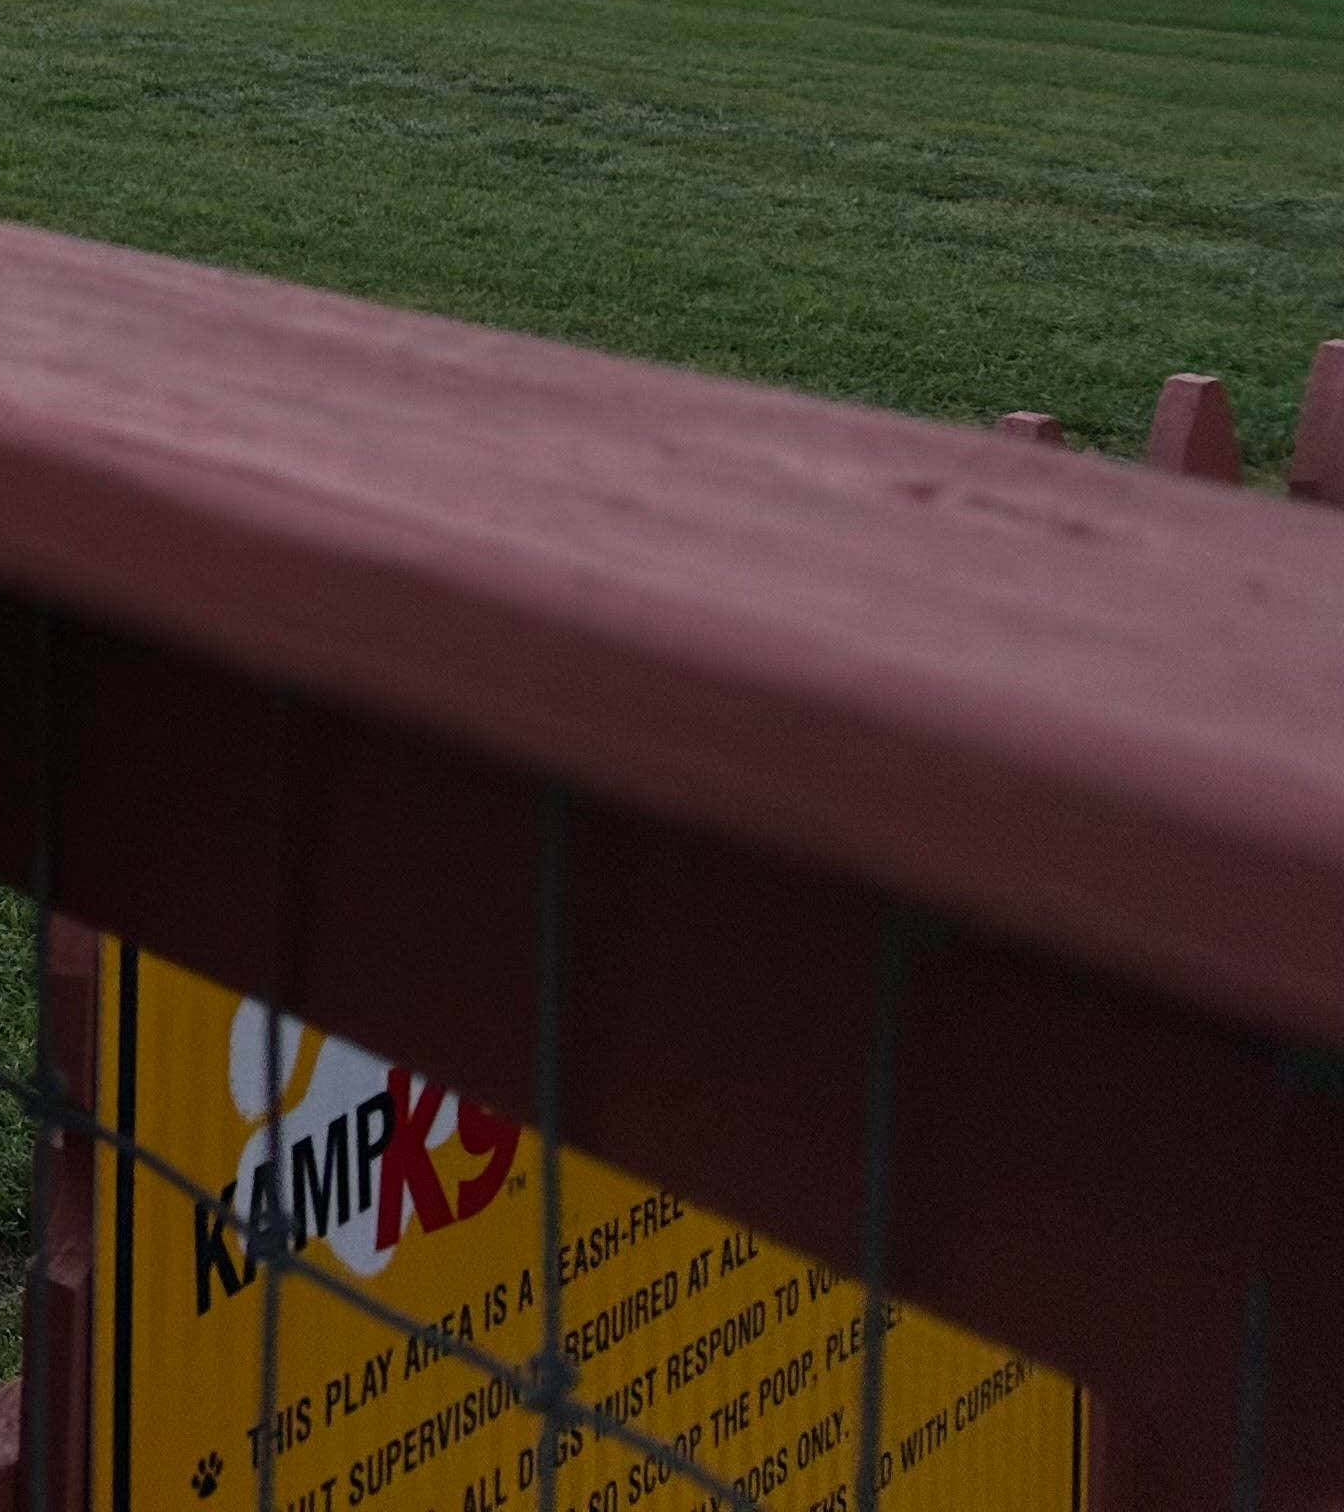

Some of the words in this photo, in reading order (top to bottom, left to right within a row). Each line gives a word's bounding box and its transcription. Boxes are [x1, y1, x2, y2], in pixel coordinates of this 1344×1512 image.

[247, 1396, 312, 1469] THIS
[325, 1349, 394, 1427] PLAY
[485, 1284, 507, 1332] IS
[518, 1269, 534, 1313] A
[556, 1191, 685, 1288] EASH-FREE
[564, 1271, 678, 1363] REQUIRED
[687, 1249, 712, 1296] AT
[720, 1228, 759, 1276] ALL
[464, 1467, 508, 1512] ALL
[519, 1430, 583, 1491] DGS
[666, 1301, 765, 1394] RESPOND
[774, 1279, 799, 1323] TO
[711, 1391, 749, 1447] THE
[759, 1350, 818, 1417] POOP,
[797, 1407, 850, 1470] ONLY.
[900, 1407, 948, 1473] WITH
